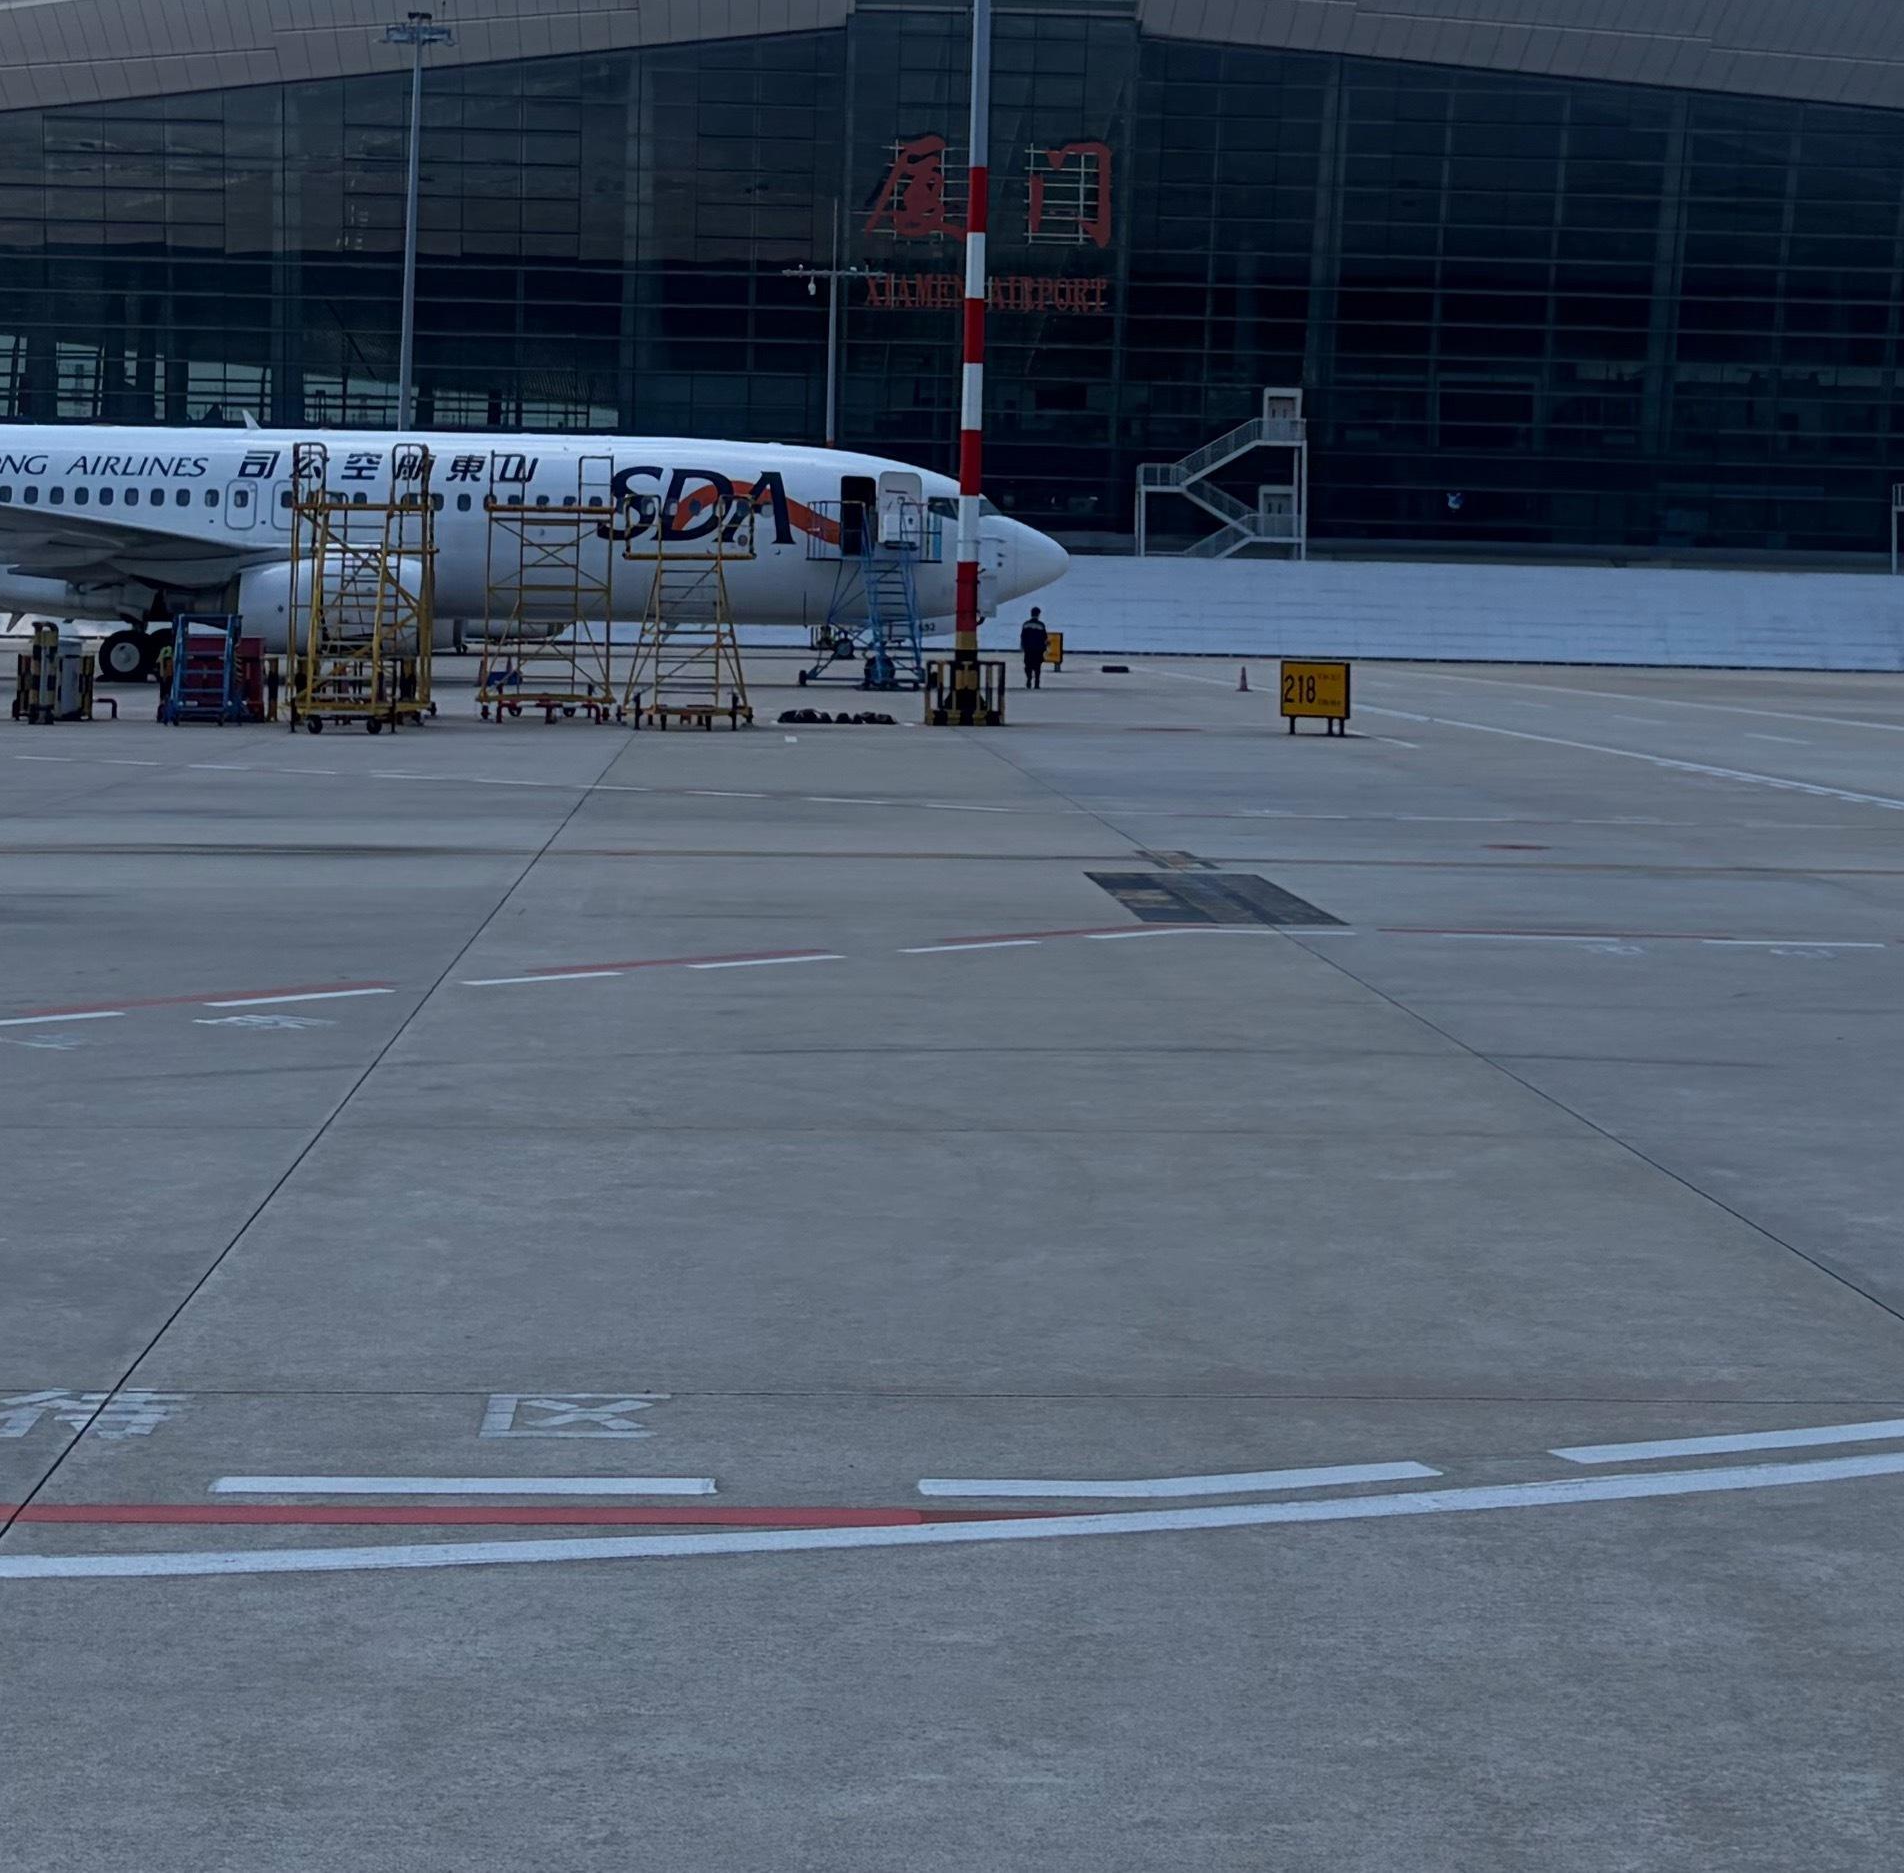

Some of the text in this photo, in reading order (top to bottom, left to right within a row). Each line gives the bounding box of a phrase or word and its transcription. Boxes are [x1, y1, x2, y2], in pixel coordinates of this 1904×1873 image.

[65, 455, 210, 477] AIRLINES
[597, 466, 796, 544] SDA
[1284, 673, 1316, 704] 218
